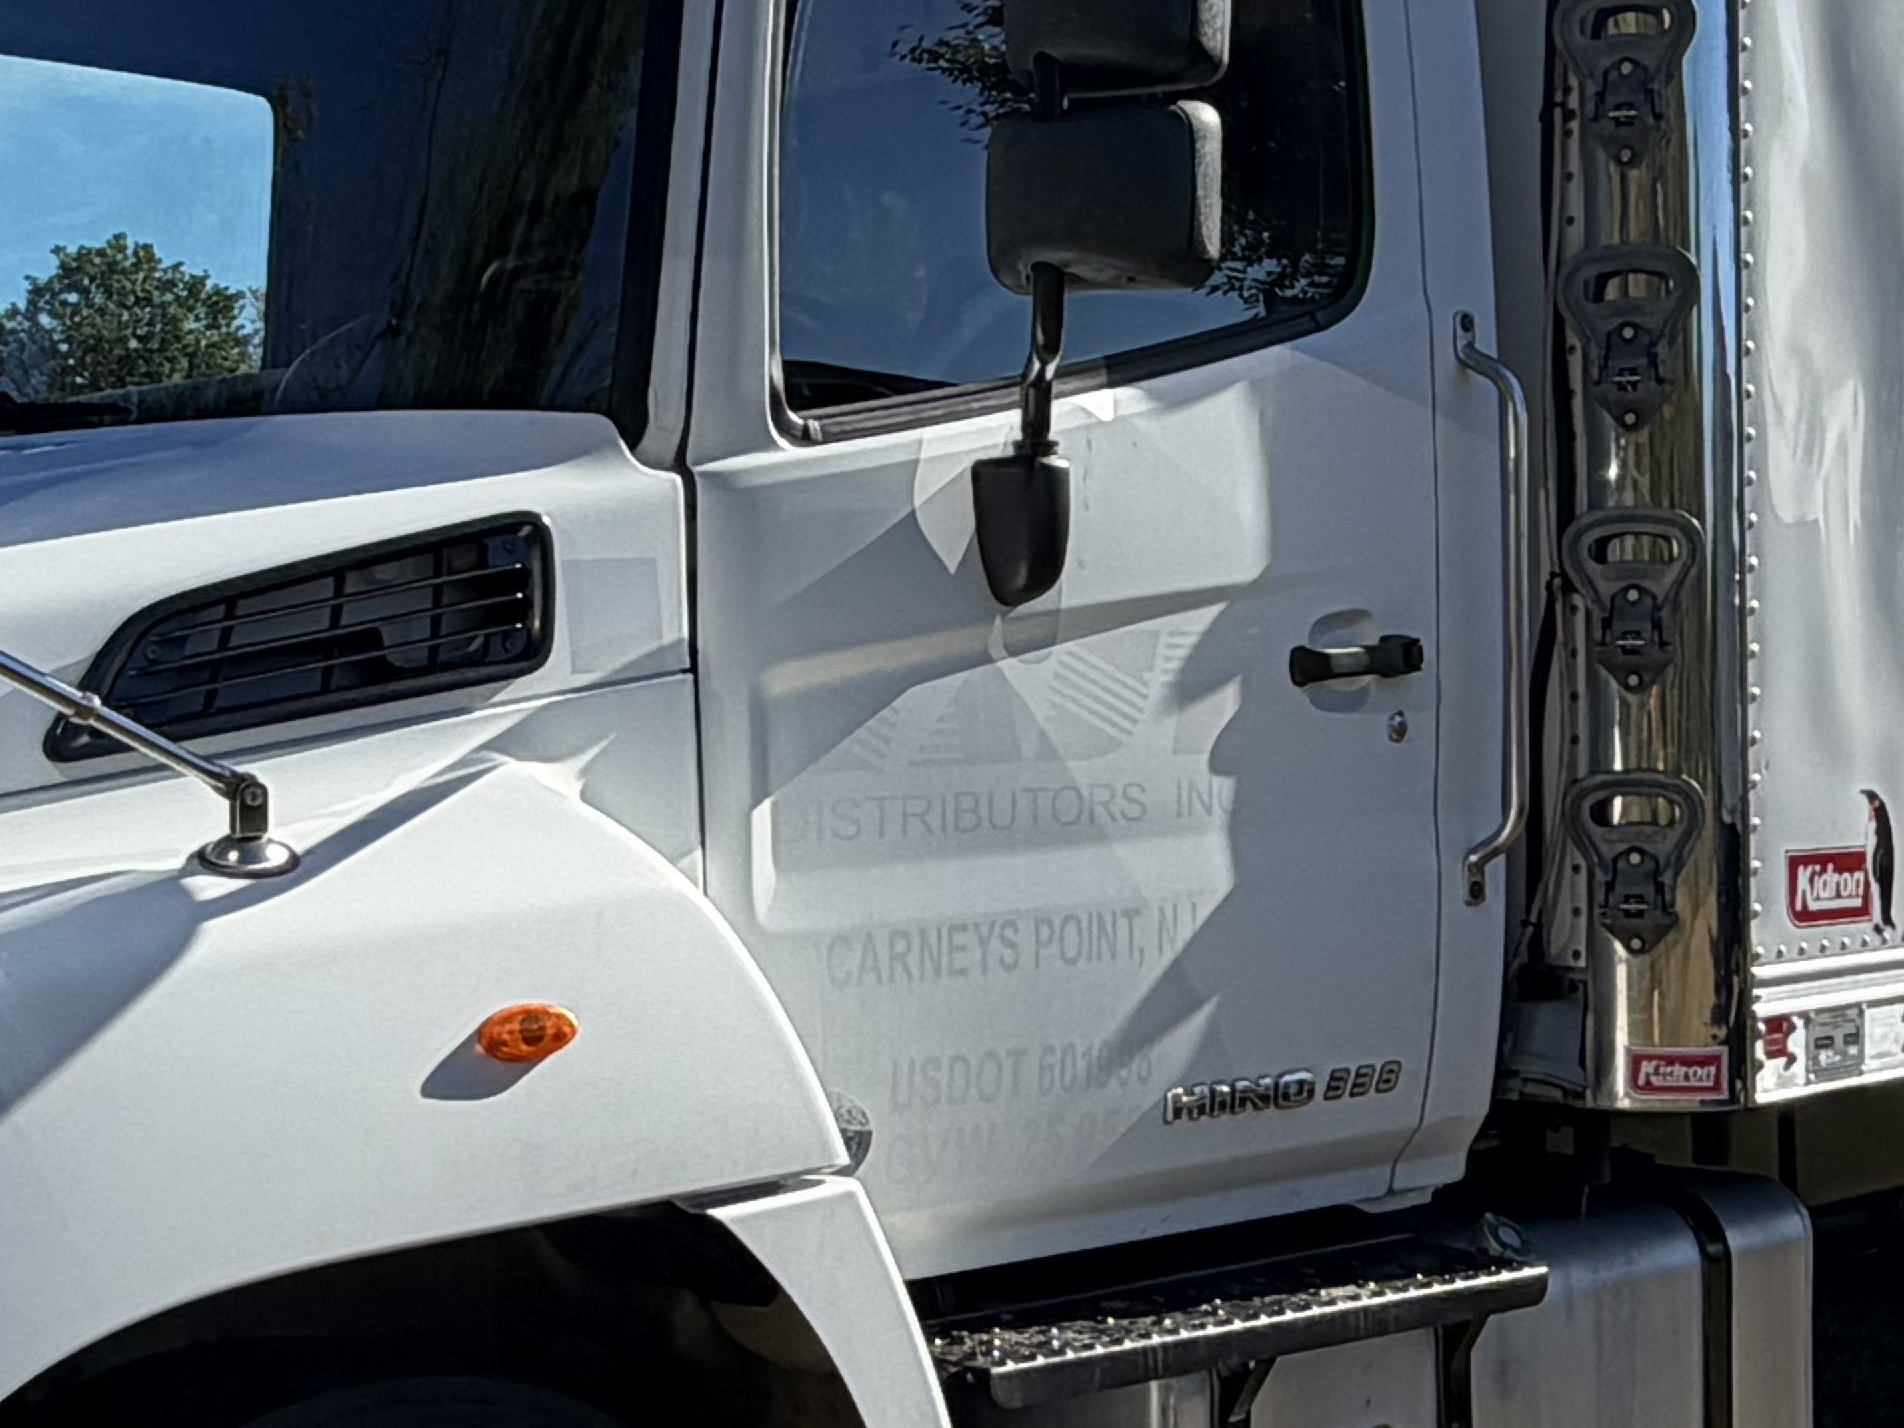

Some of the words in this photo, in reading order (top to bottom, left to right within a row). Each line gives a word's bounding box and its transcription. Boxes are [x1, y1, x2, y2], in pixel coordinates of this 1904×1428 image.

[1796, 862, 1864, 912] Kidron
[826, 918, 1021, 990] CARNEYS
[1033, 907, 1146, 968] POINT,
[891, 1047, 1028, 1112] USDOT
[1163, 1067, 1316, 1125] HINO
[1323, 1059, 1402, 1102] 338
[1637, 1059, 1718, 1086] Kidron
